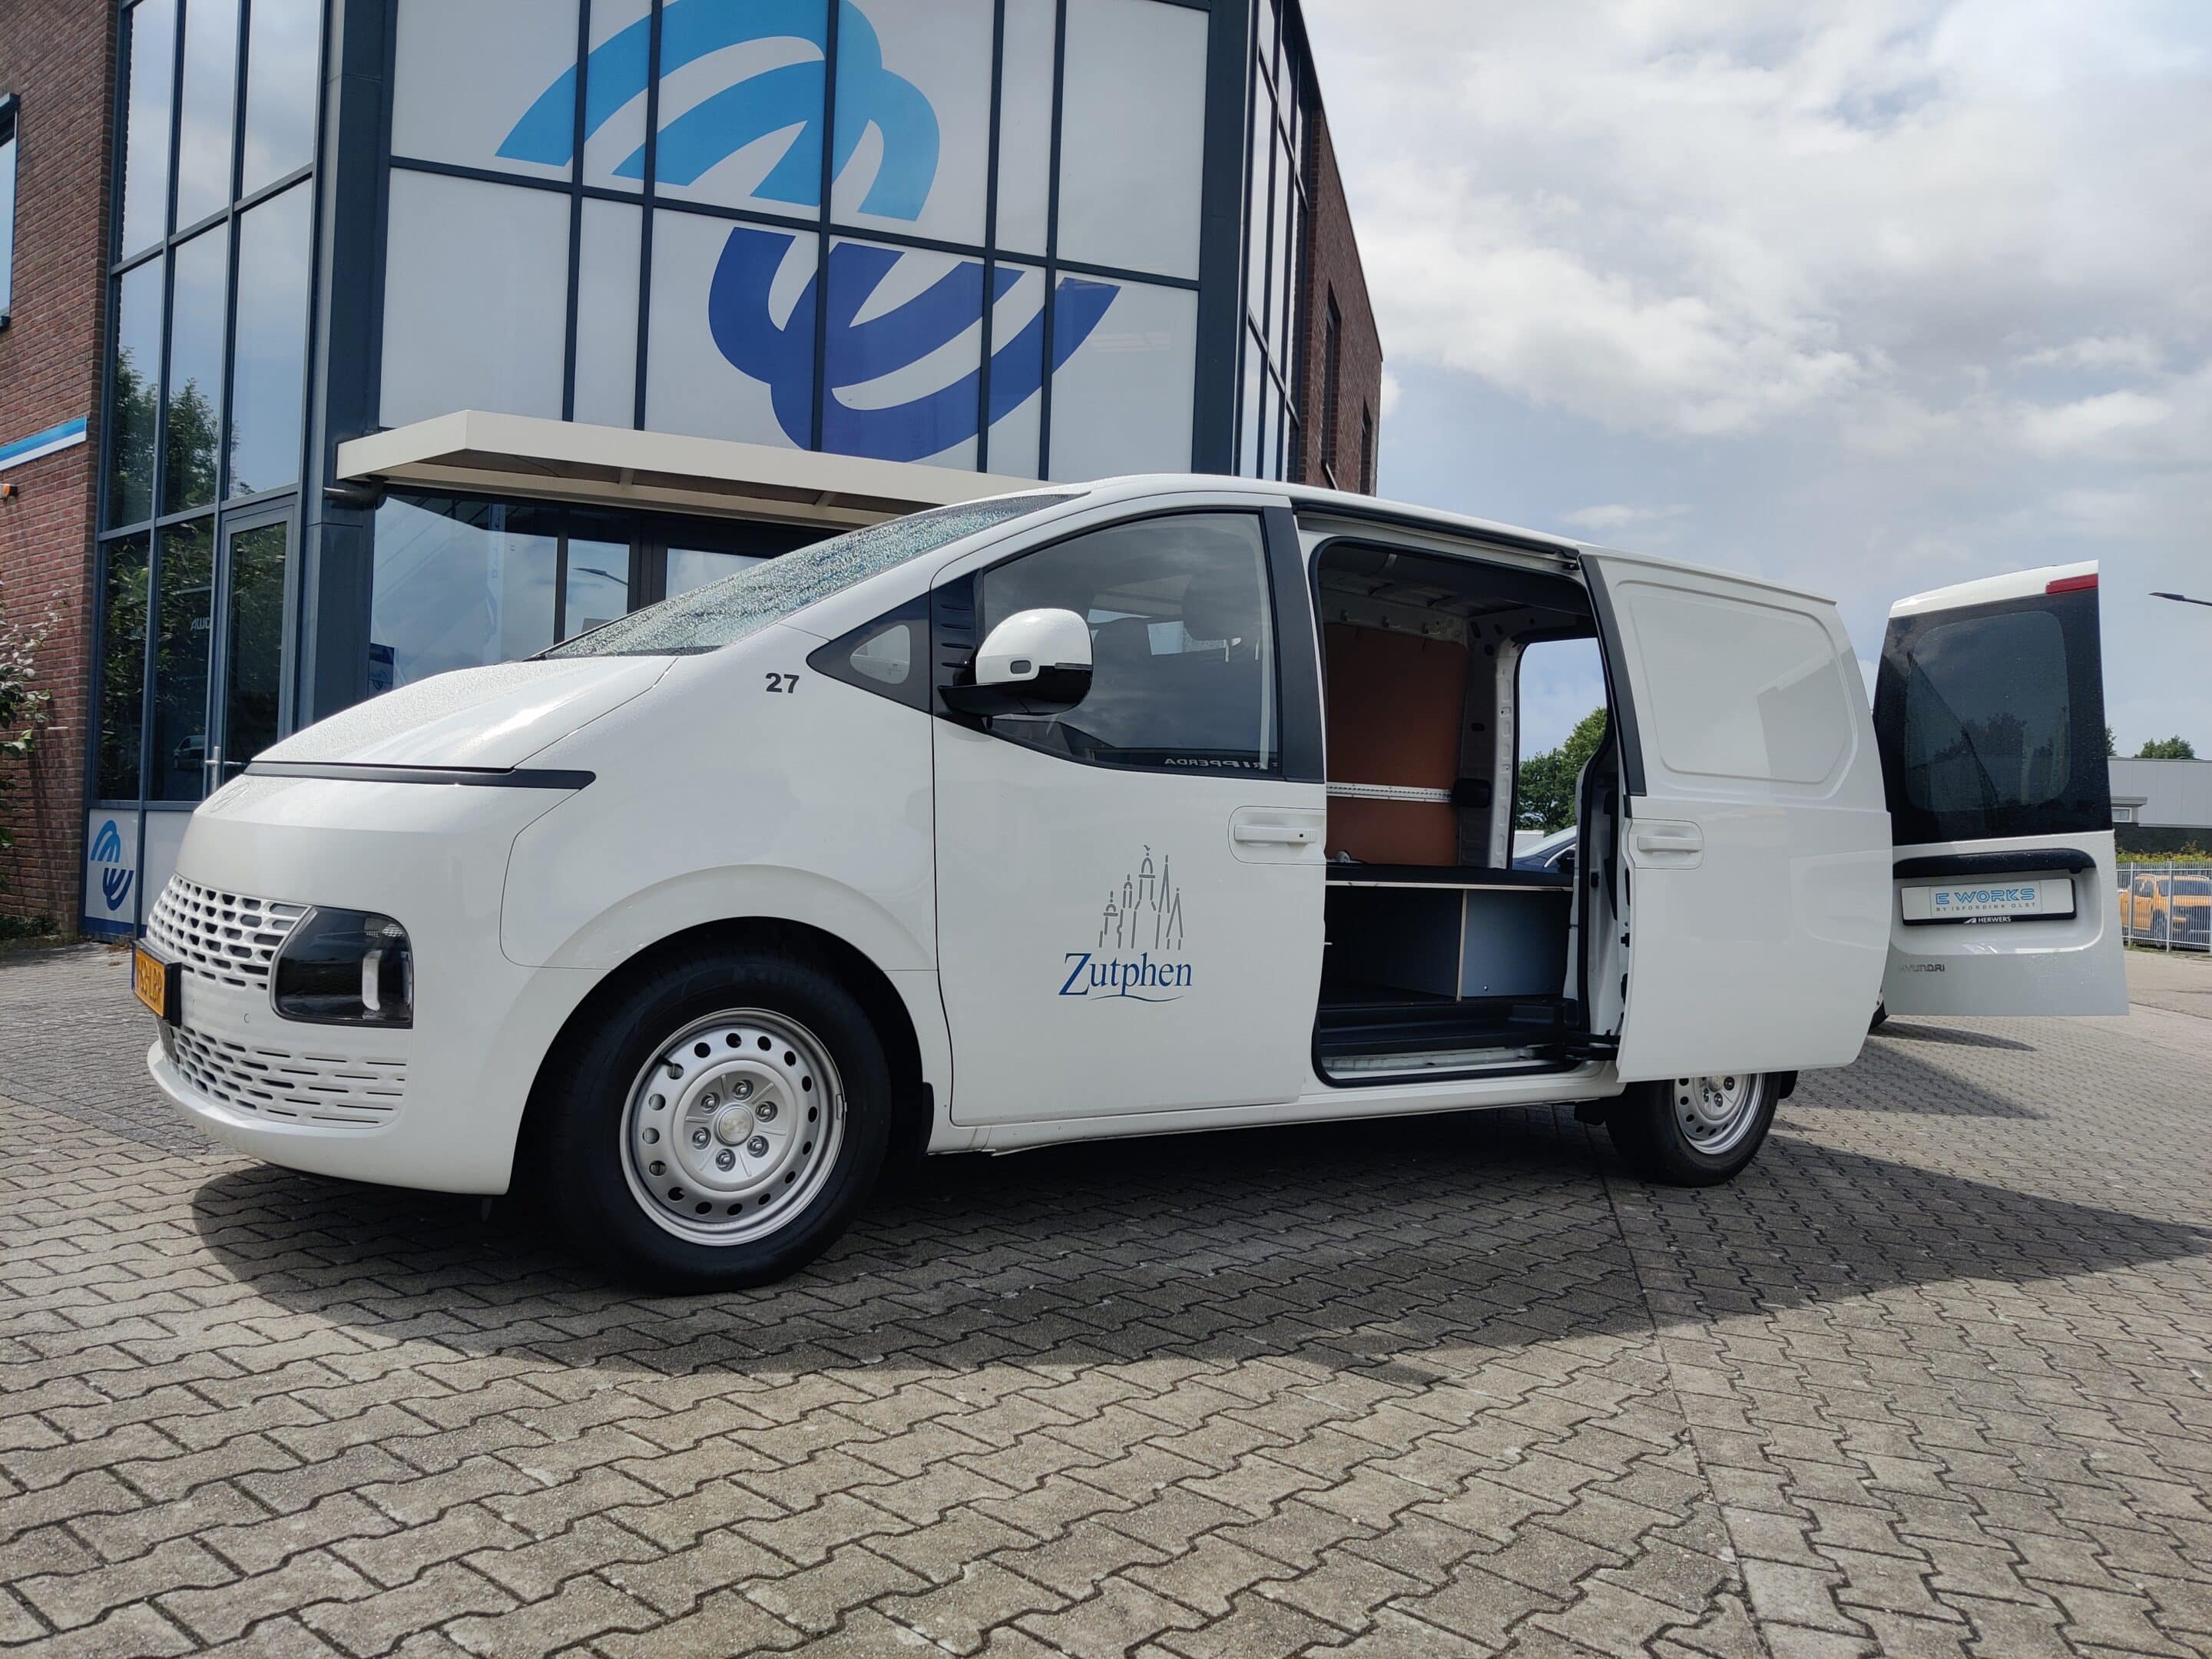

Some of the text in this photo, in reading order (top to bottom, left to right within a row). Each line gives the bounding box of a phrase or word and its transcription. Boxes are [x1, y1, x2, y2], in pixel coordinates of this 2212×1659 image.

[766, 673, 800, 694] 27
[1935, 888, 2035, 905] E WORKS
[1058, 952, 1192, 996] Zutphen
